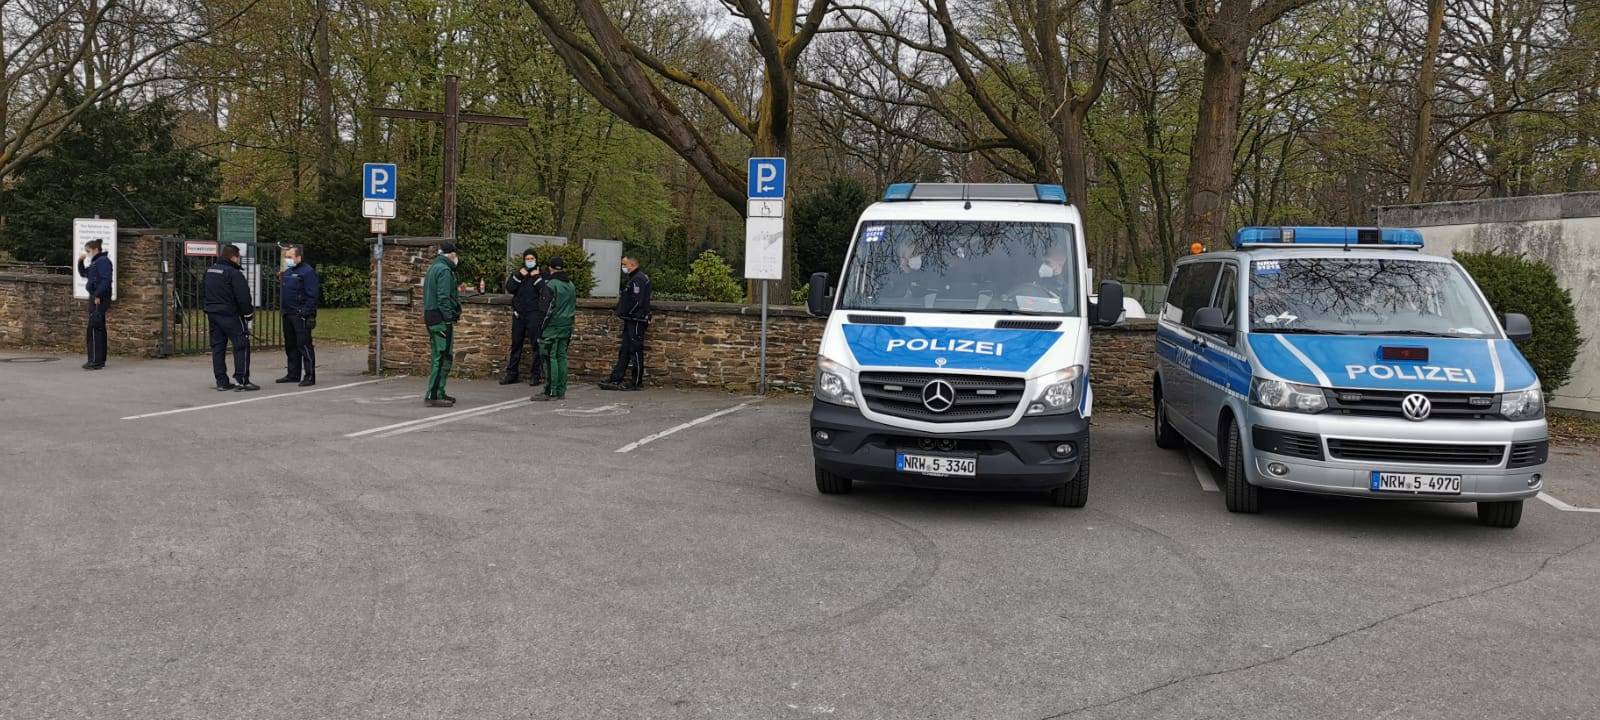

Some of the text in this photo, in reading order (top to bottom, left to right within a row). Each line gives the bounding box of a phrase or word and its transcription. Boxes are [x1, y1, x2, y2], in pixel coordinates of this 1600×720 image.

[371, 168, 389, 195] P
[757, 163, 777, 193] P
[886, 338, 1003, 356] POLIZEI
[1345, 364, 1477, 384] POLIZEI
[904, 455, 975, 473] NRW 5-3340
[1380, 475, 1460, 491] NRW 5-4970
